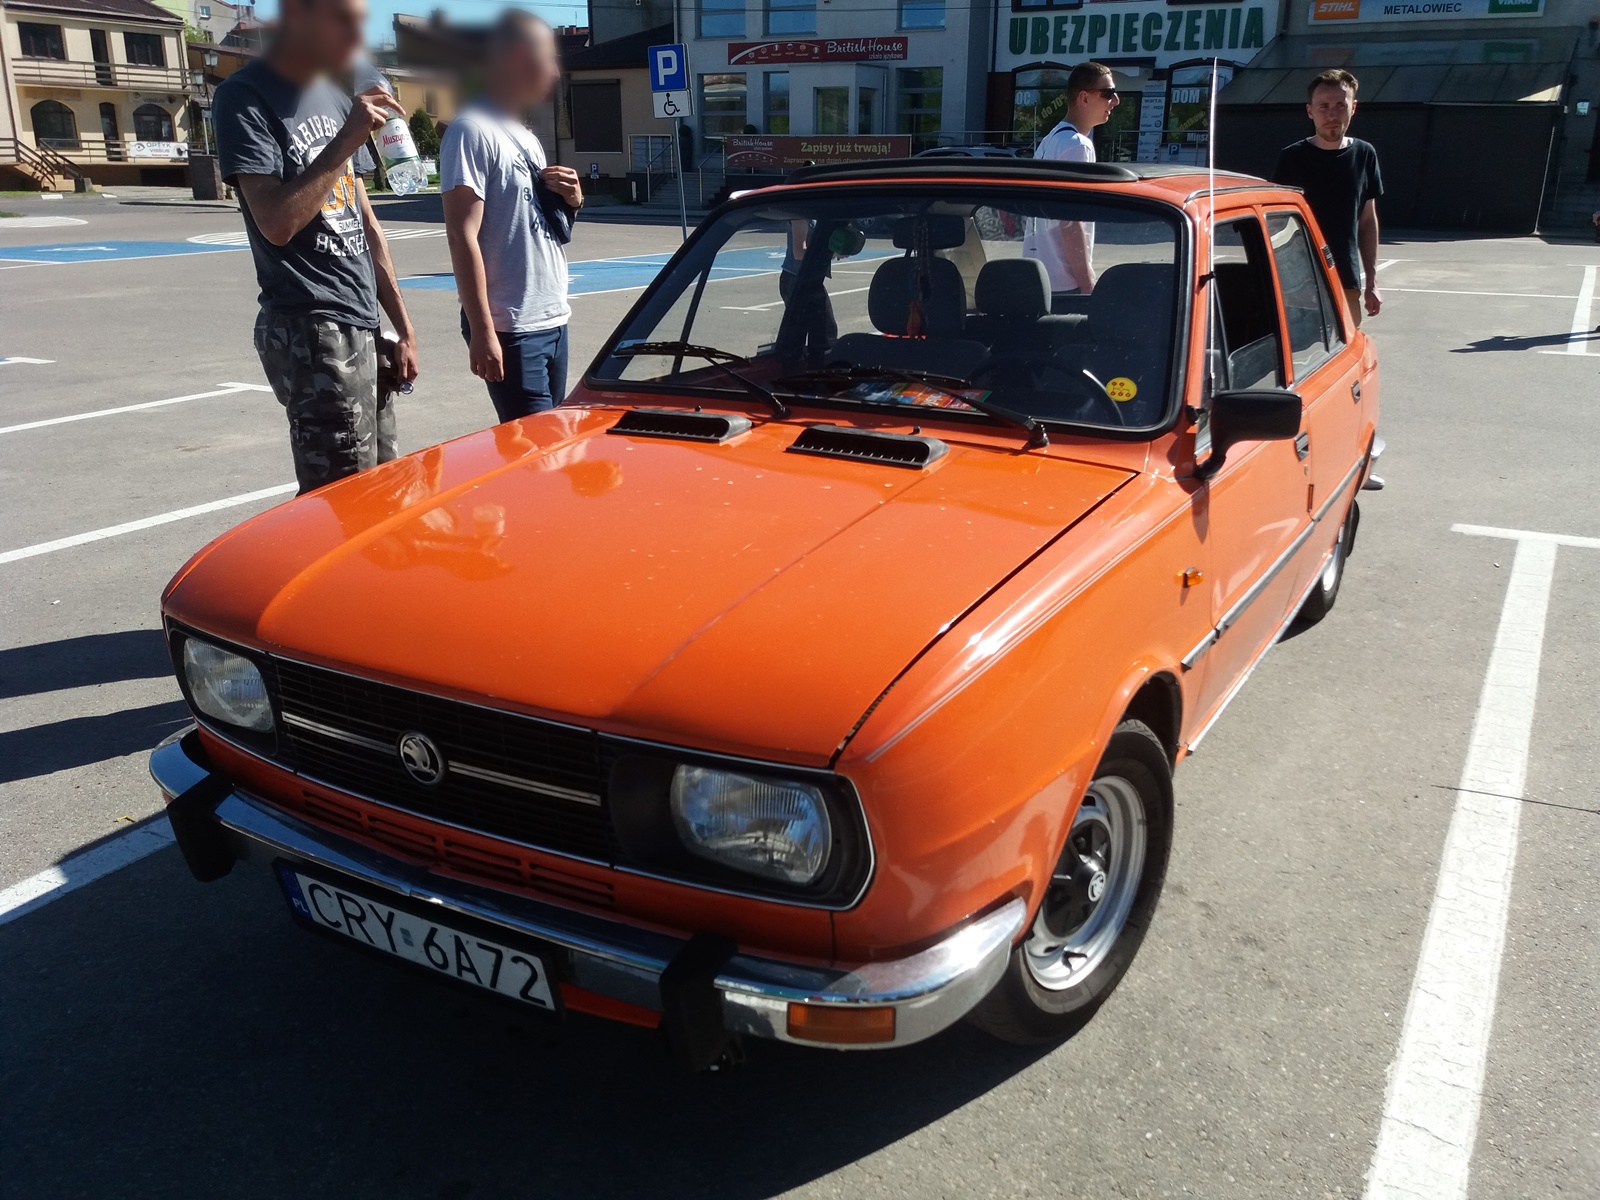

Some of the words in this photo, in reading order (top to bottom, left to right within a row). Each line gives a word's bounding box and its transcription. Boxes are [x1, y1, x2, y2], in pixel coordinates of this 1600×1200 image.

[1318, 2, 1355, 13] STIHL
[1384, 3, 1461, 15] METALOWIEC
[1009, 7, 1263, 54] UBEZPIECZENIA
[825, 38, 867, 54] British
[867, 37, 903, 52] House
[657, 50, 678, 86] P
[1171, 89, 1200, 104] DOM
[800, 142, 834, 155] Zapisy
[835, 142, 851, 155] już
[854, 143, 891, 156] trwają!
[291, 897, 309, 913] PL
[308, 883, 397, 953] CRY
[424, 926, 547, 1006] 6A72
